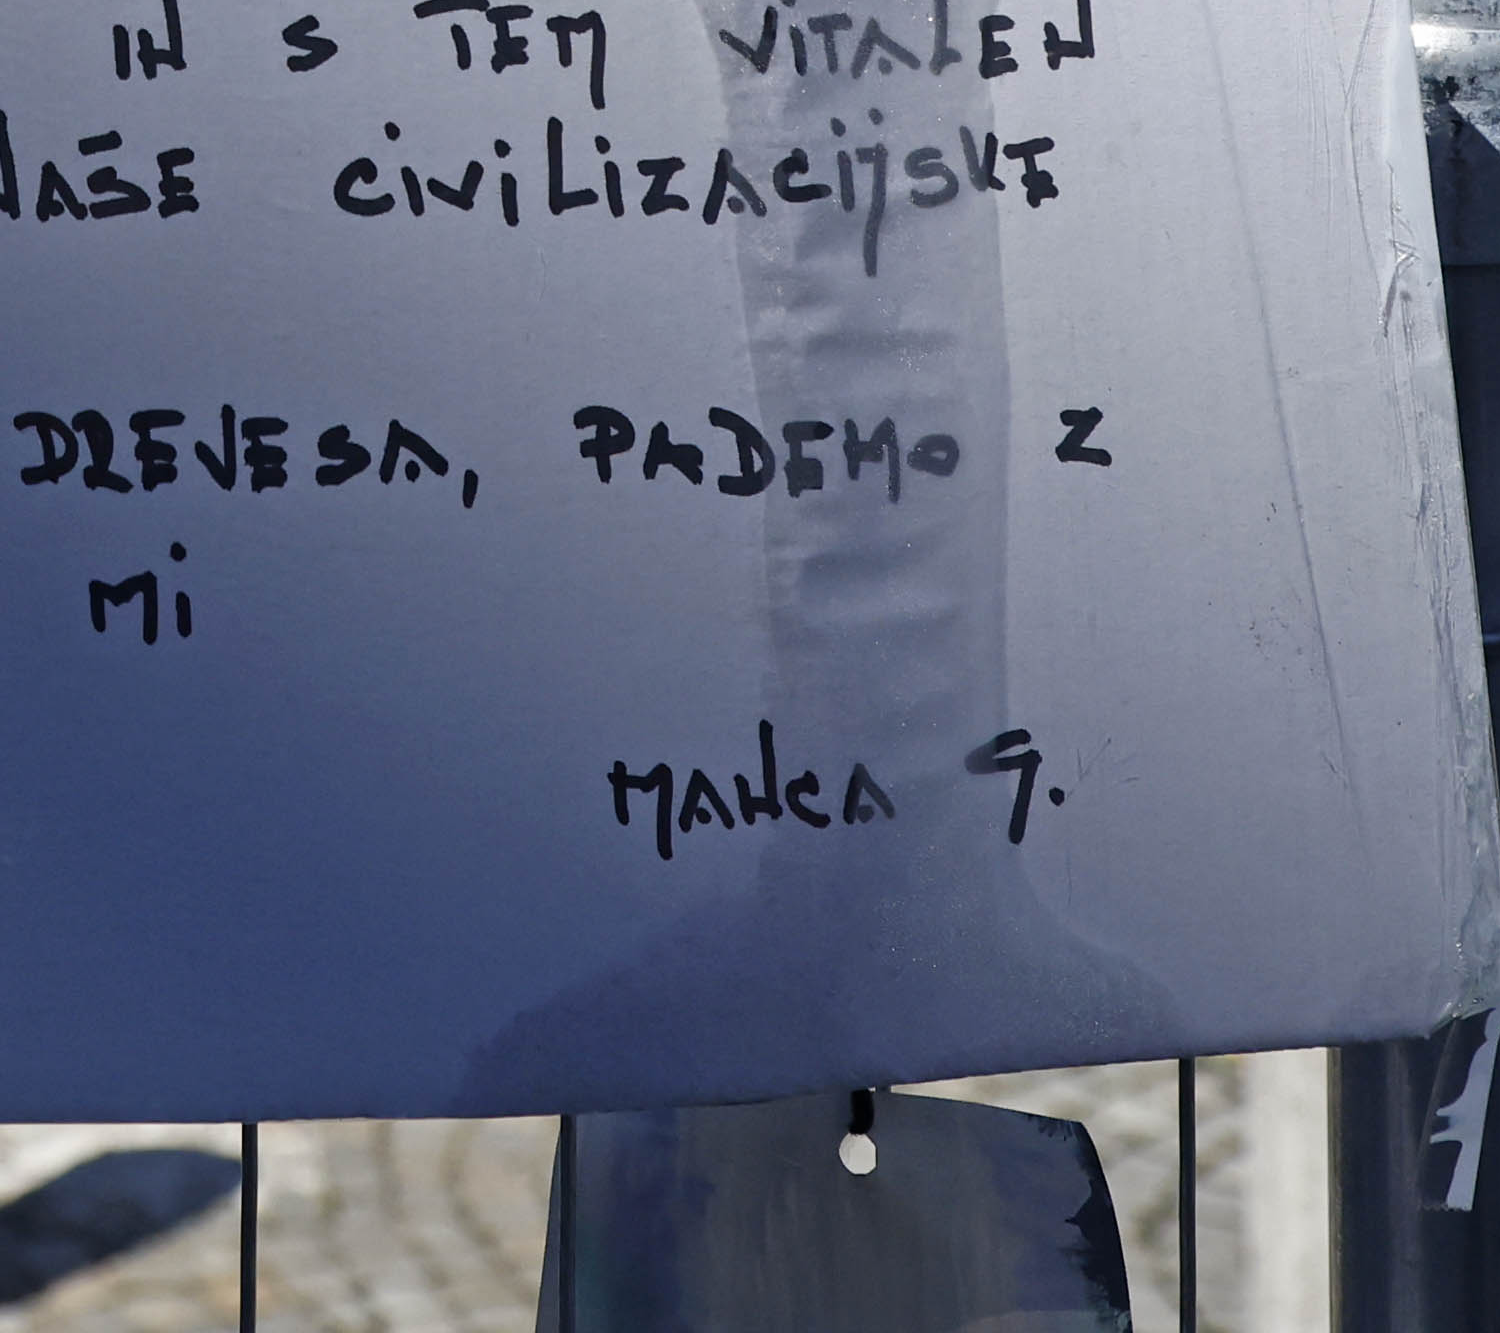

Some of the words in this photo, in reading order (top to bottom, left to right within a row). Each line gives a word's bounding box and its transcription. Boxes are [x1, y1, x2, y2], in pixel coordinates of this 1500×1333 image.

[14, 403, 478, 508] DREVESA,
[573, 405, 959, 505] PADEMO
[607, 719, 894, 859] MANCA
